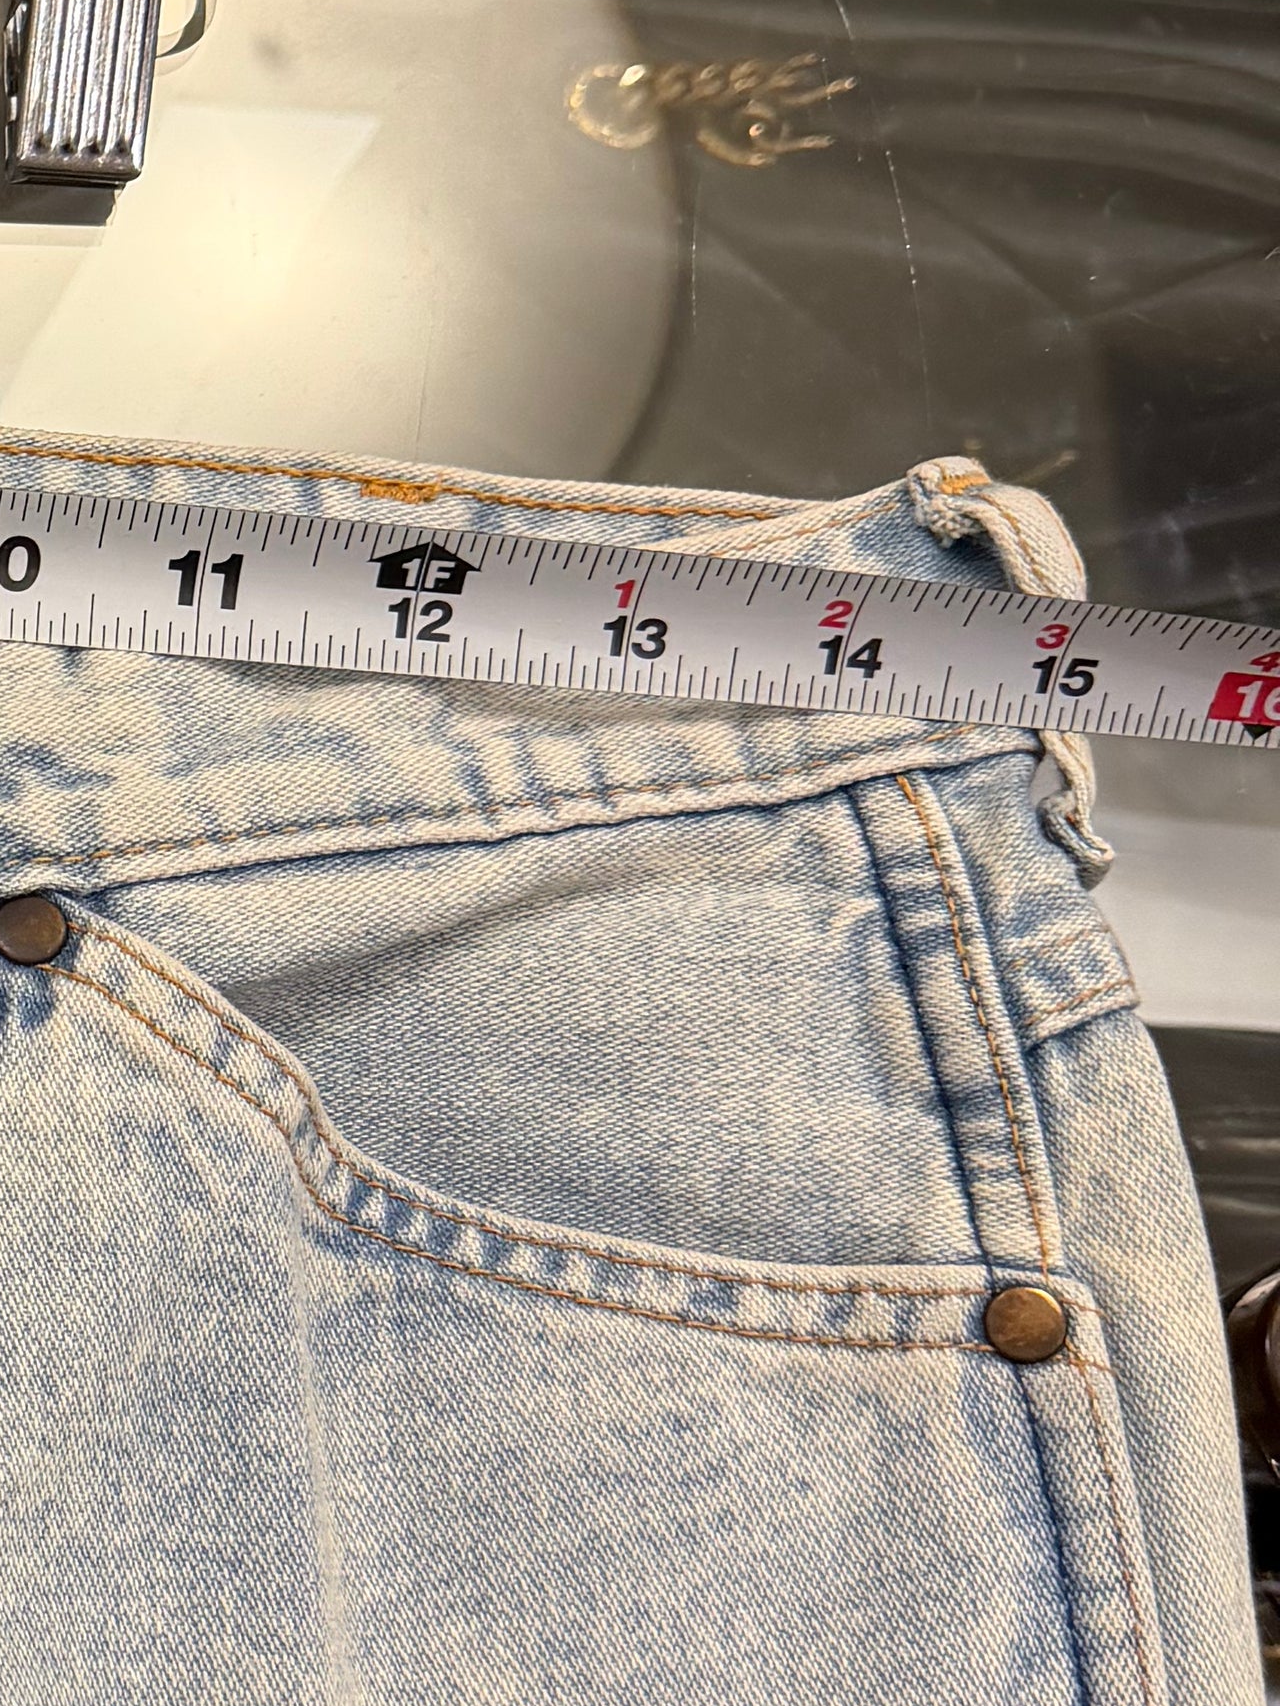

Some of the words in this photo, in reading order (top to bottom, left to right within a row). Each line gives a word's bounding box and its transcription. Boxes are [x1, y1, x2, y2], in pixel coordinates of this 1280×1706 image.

[168, 549, 244, 610] 11
[401, 557, 456, 589] 1F
[614, 579, 635, 608] 1
[388, 597, 454, 643] 12
[817, 600, 855, 629] 2
[603, 615, 667, 660] 13
[818, 634, 883, 679] 14
[1035, 624, 1070, 650] 3
[1032, 655, 1100, 698] 15
